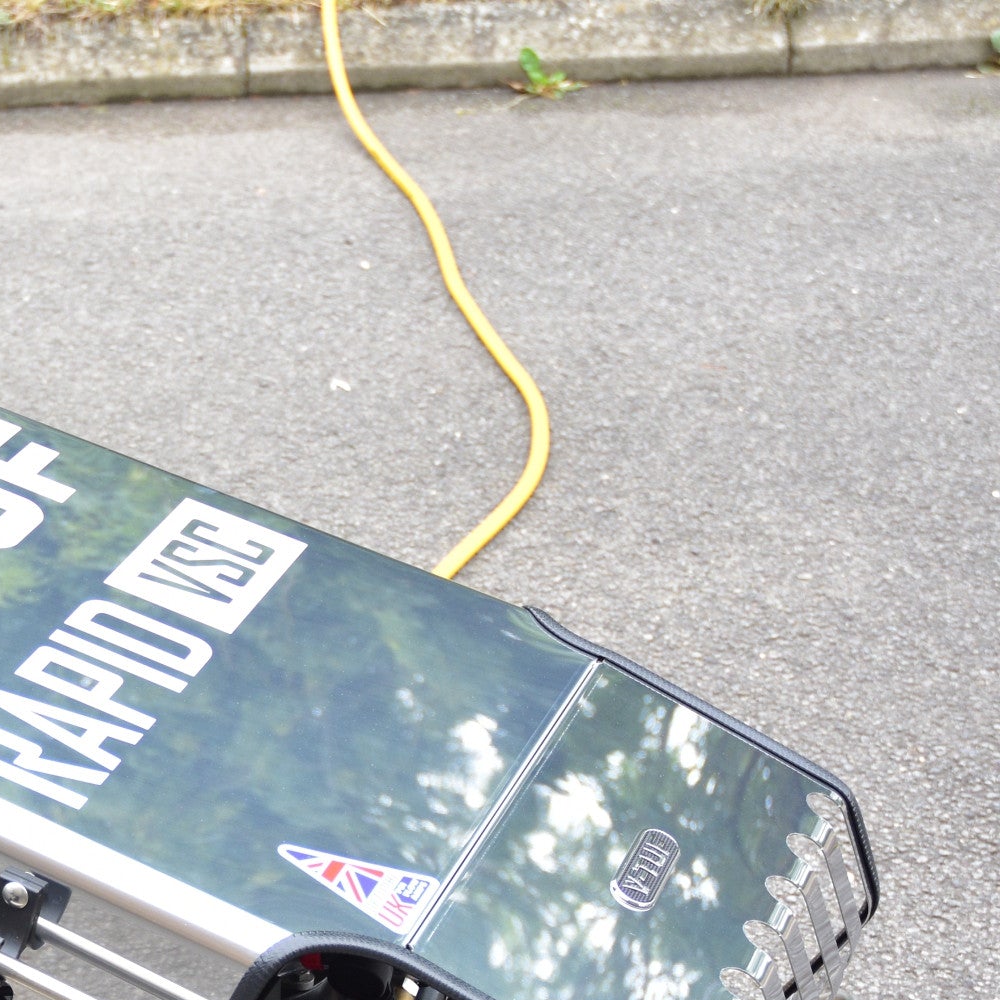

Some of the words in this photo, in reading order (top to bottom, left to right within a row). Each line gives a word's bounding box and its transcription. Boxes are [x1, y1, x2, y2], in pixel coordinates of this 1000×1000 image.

[138, 518, 278, 605] VSC
[622, 833, 670, 895] V-TUF
[378, 893, 413, 928] UK
